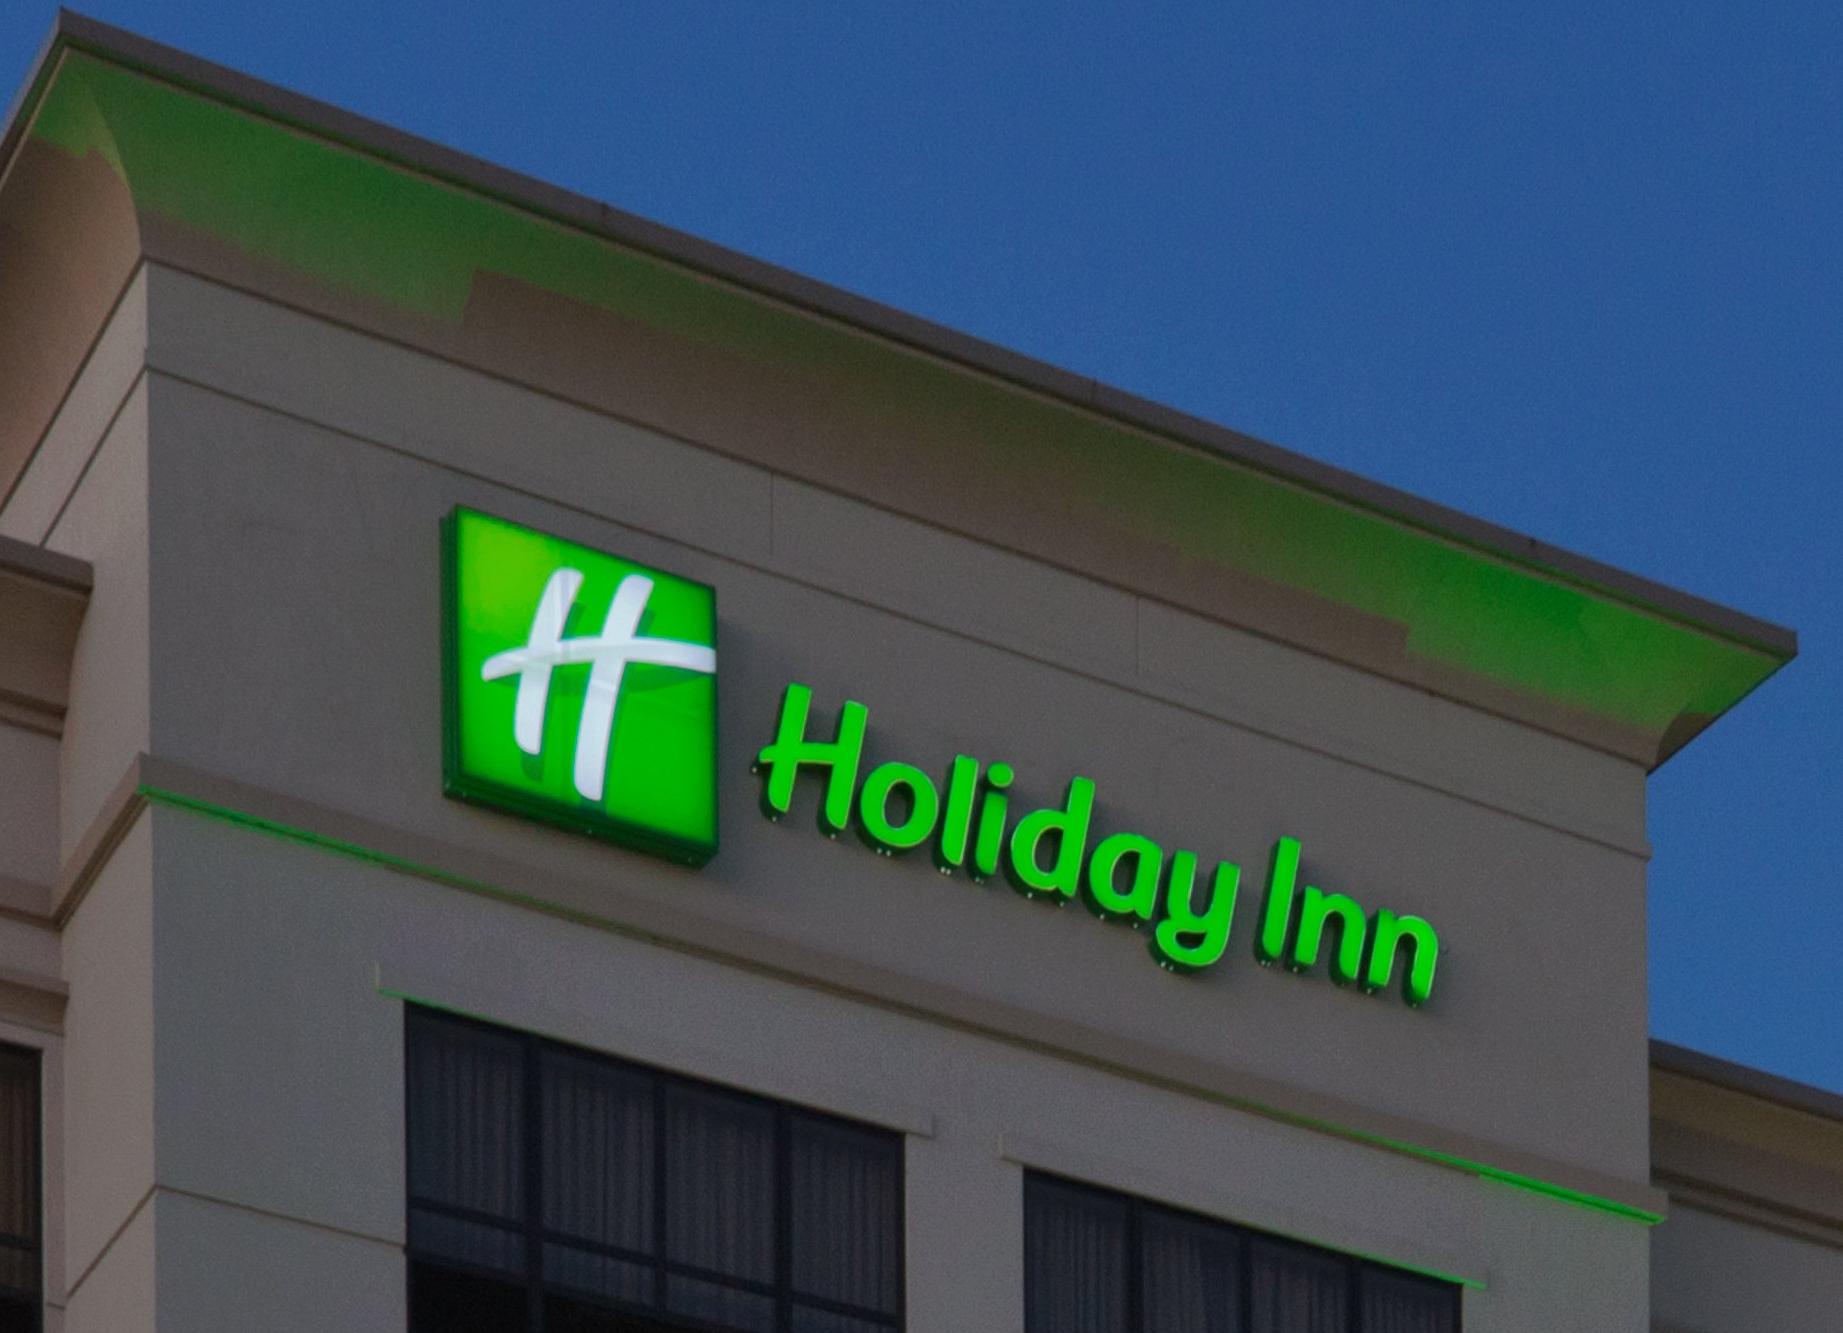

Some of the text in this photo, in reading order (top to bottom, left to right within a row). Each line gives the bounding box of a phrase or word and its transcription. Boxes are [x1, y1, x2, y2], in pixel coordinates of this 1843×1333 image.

[480, 566, 716, 801] H
[758, 682, 1439, 1001] Holiday Inn
